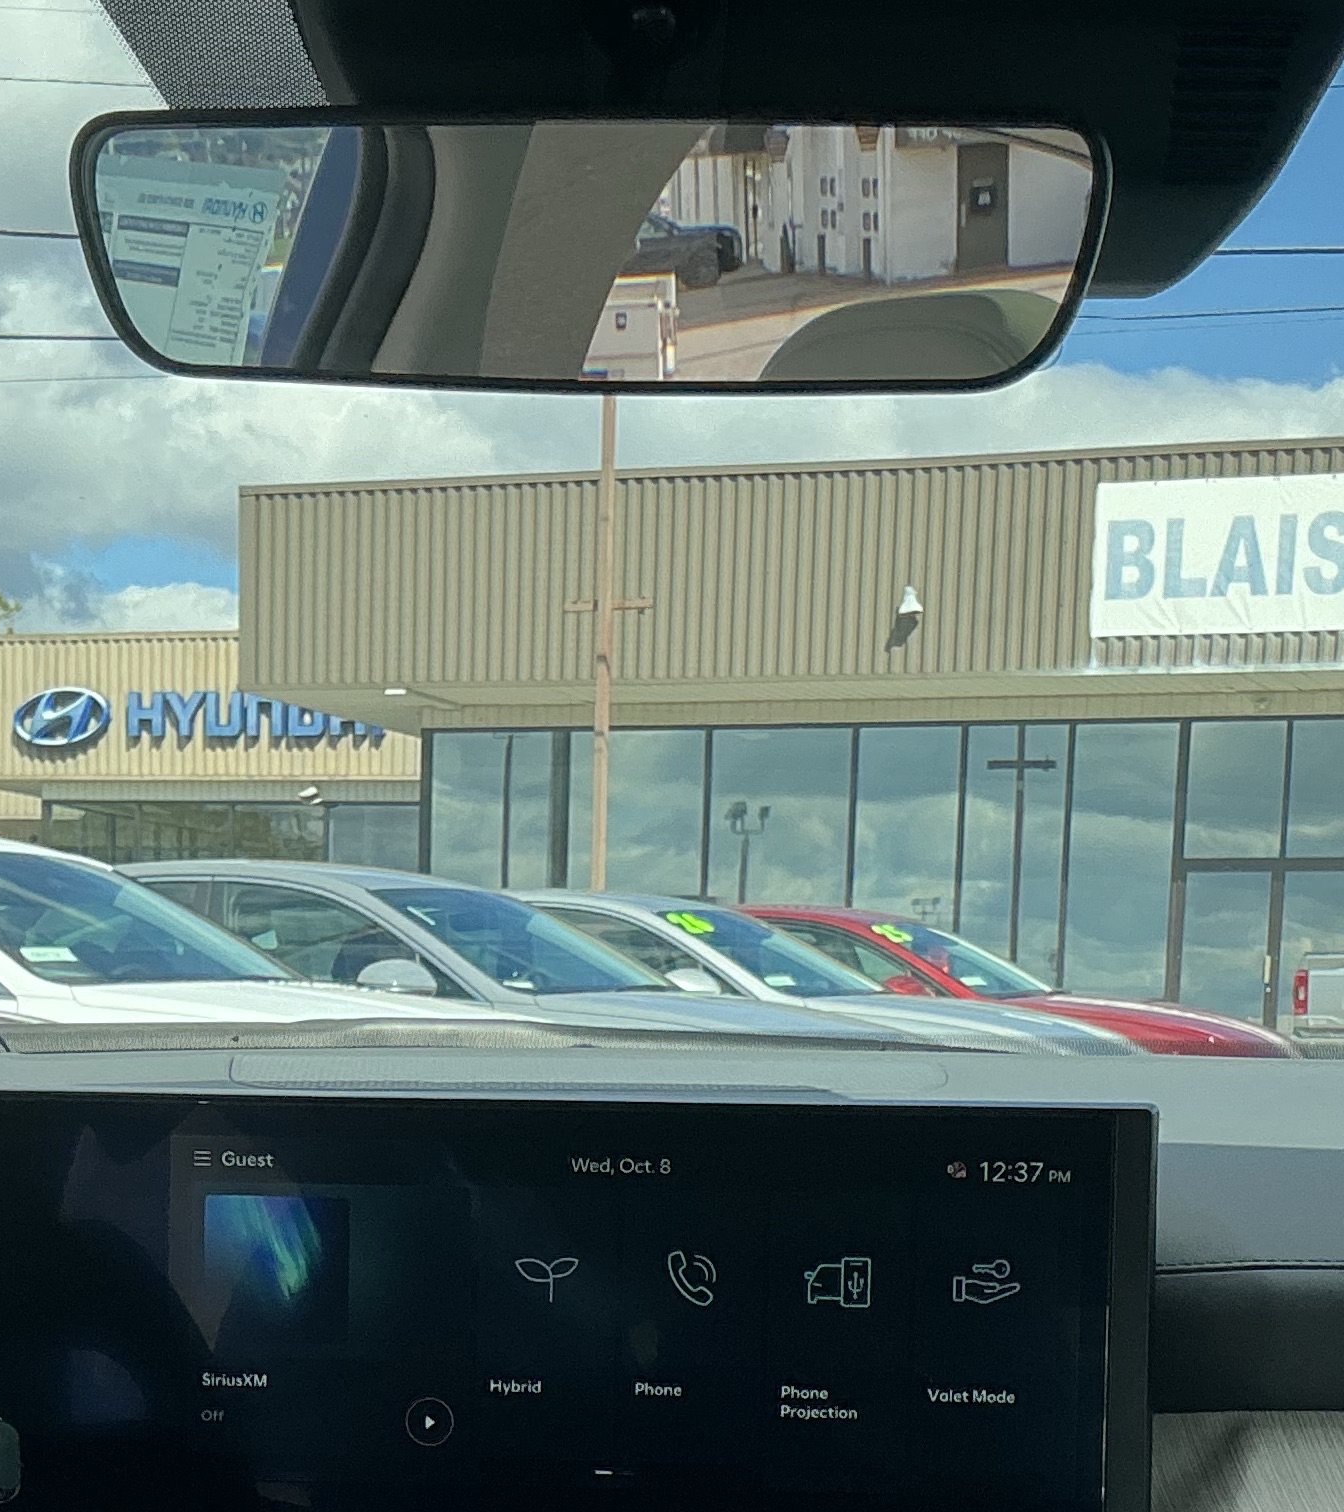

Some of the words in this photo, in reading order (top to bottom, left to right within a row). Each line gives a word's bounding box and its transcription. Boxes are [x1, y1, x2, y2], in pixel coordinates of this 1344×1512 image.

[126, 690, 386, 738] HYUND
[220, 1151, 274, 1169] Guest
[571, 1157, 615, 1176] Wed,
[618, 1157, 656, 1175] Oct.
[659, 1158, 672, 1175] 8
[979, 1160, 1044, 1183] 12:37
[1048, 1170, 1072, 1184] PM
[201, 1371, 269, 1388] SiriusXM
[489, 1378, 543, 1396] Hybrid
[634, 1382, 683, 1397] Phone
[780, 1385, 829, 1400] Phone
[927, 1388, 970, 1404] Valet
[973, 1389, 1016, 1405] Mode
[200, 1408, 226, 1423] Off
[780, 1404, 858, 1421] Projection
